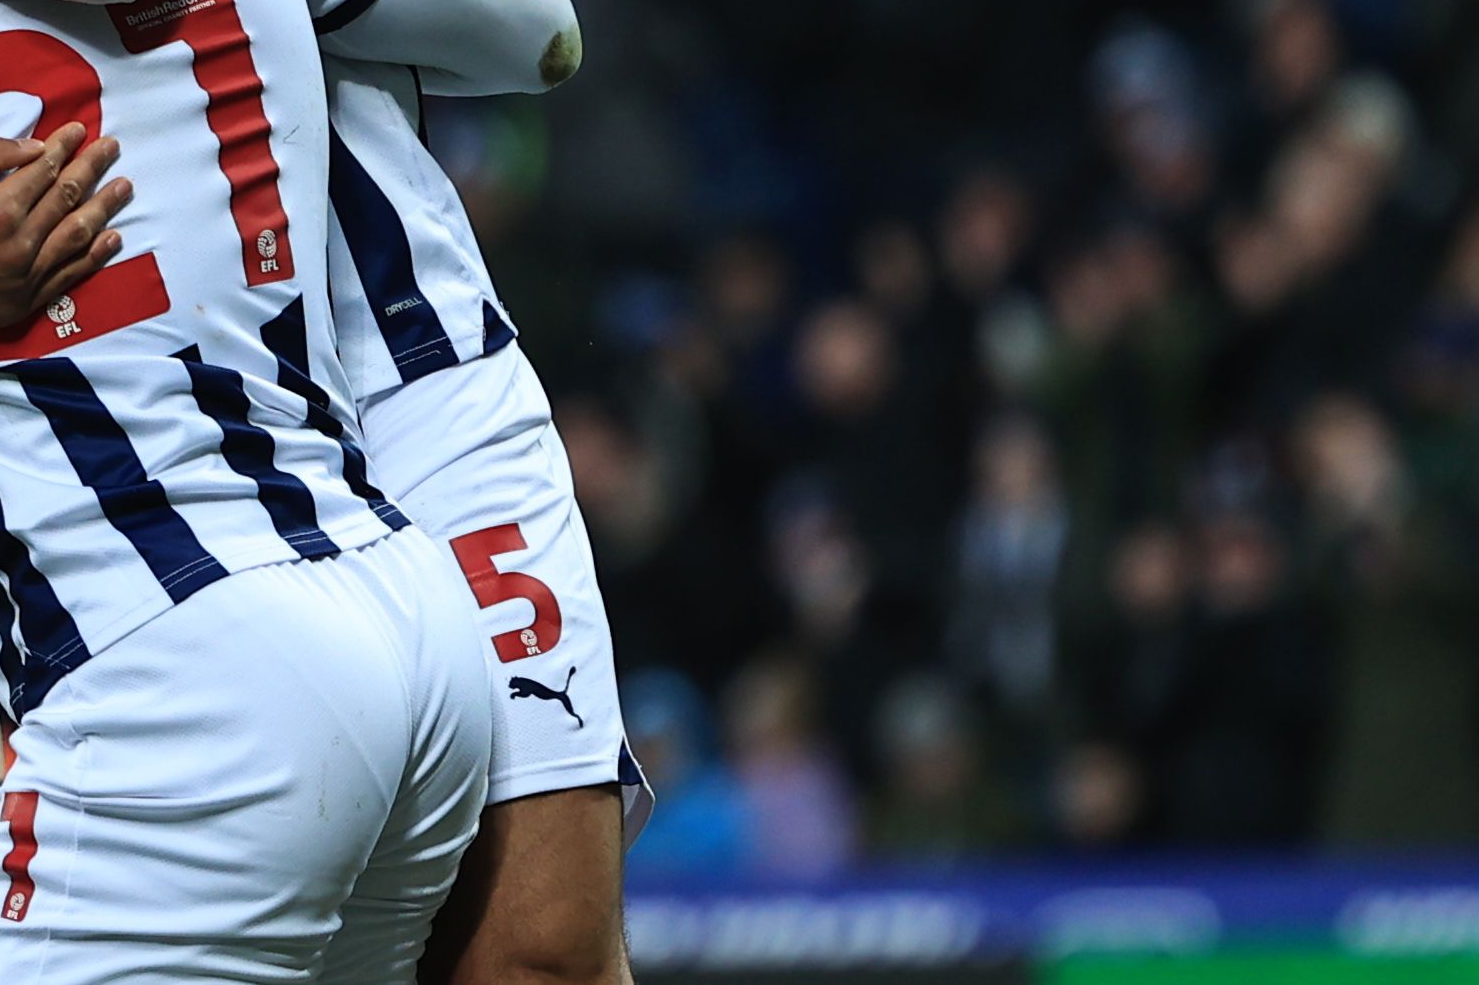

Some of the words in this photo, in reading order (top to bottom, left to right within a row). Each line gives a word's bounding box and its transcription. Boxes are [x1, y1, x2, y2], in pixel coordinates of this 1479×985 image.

[261, 259, 279, 273] EFL
[384, 297, 423, 316] DRYCELL
[55, 321, 82, 339] EFL
[449, 522, 562, 663] 5
[526, 645, 542, 656] EFL
